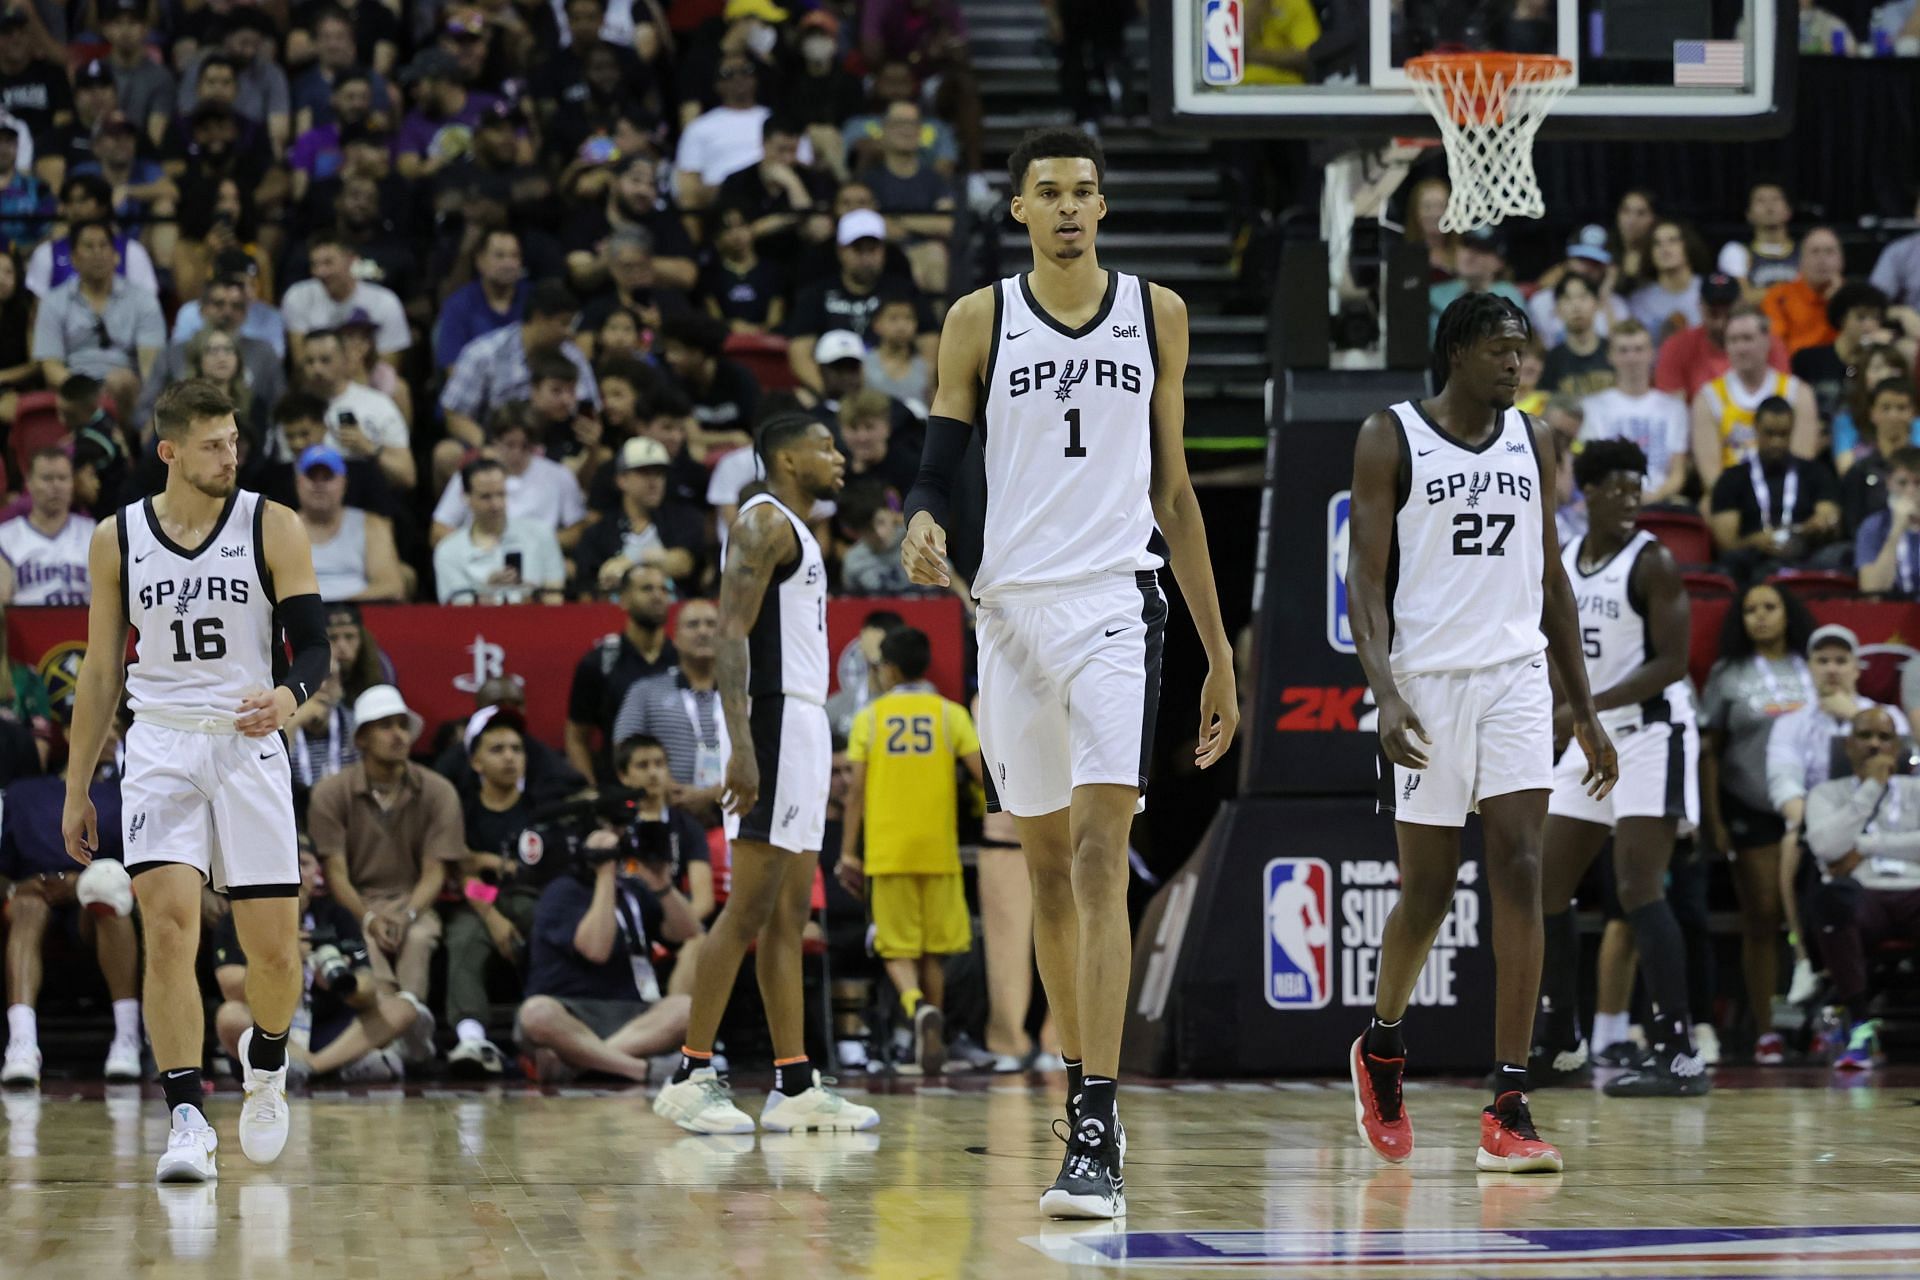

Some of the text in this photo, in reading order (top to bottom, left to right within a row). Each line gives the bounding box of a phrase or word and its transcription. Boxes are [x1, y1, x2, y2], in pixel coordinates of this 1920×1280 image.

[1112, 325, 1141, 338] Self.
[1009, 358, 1142, 403] SPURS
[1064, 408, 1087, 458] 1
[1425, 470, 1532, 509] SPURS
[220, 544, 247, 558] Self.
[1452, 513, 1516, 557] 27
[139, 576, 249, 617] SPURS
[169, 617, 227, 662] 16
[886, 716, 933, 754] 25
[1340, 861, 1400, 885] NBA
